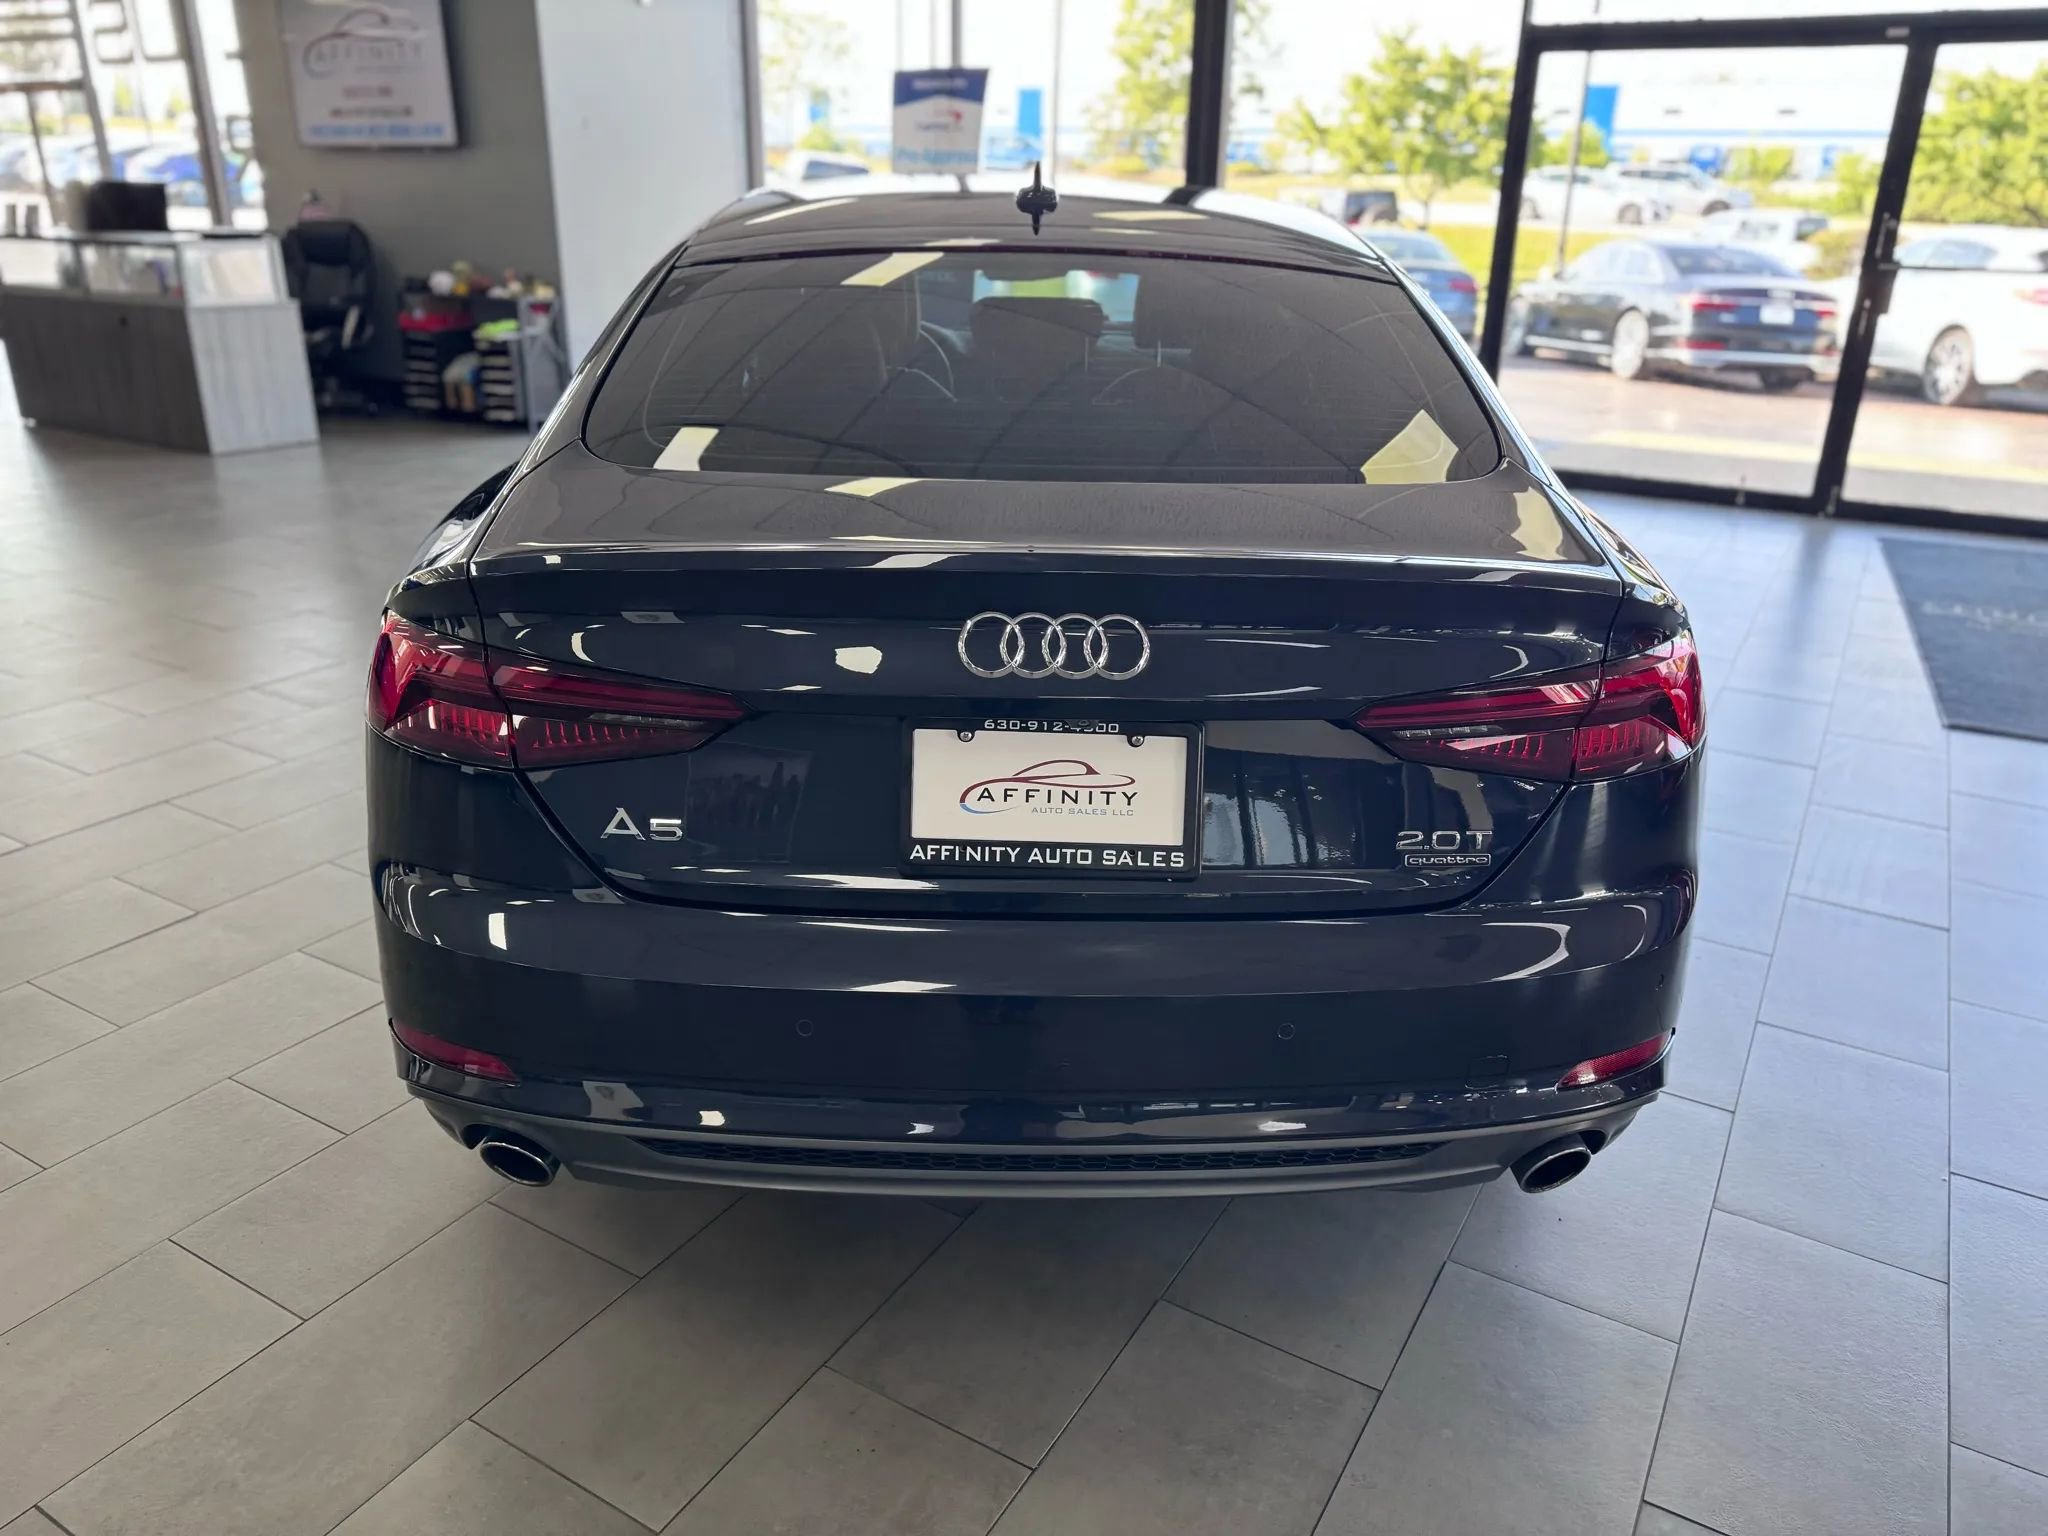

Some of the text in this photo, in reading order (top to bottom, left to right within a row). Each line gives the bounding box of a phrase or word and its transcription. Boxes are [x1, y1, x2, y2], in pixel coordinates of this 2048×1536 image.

[976, 787, 1138, 806] AFFINITY
[1031, 806, 1135, 817] AUTO SALES LLC
[600, 806, 683, 842] A5
[1396, 830, 1493, 850] 2.0T
[909, 844, 1185, 868] AFFINITY AUTO SALES
[1408, 855, 1489, 867] quattro
